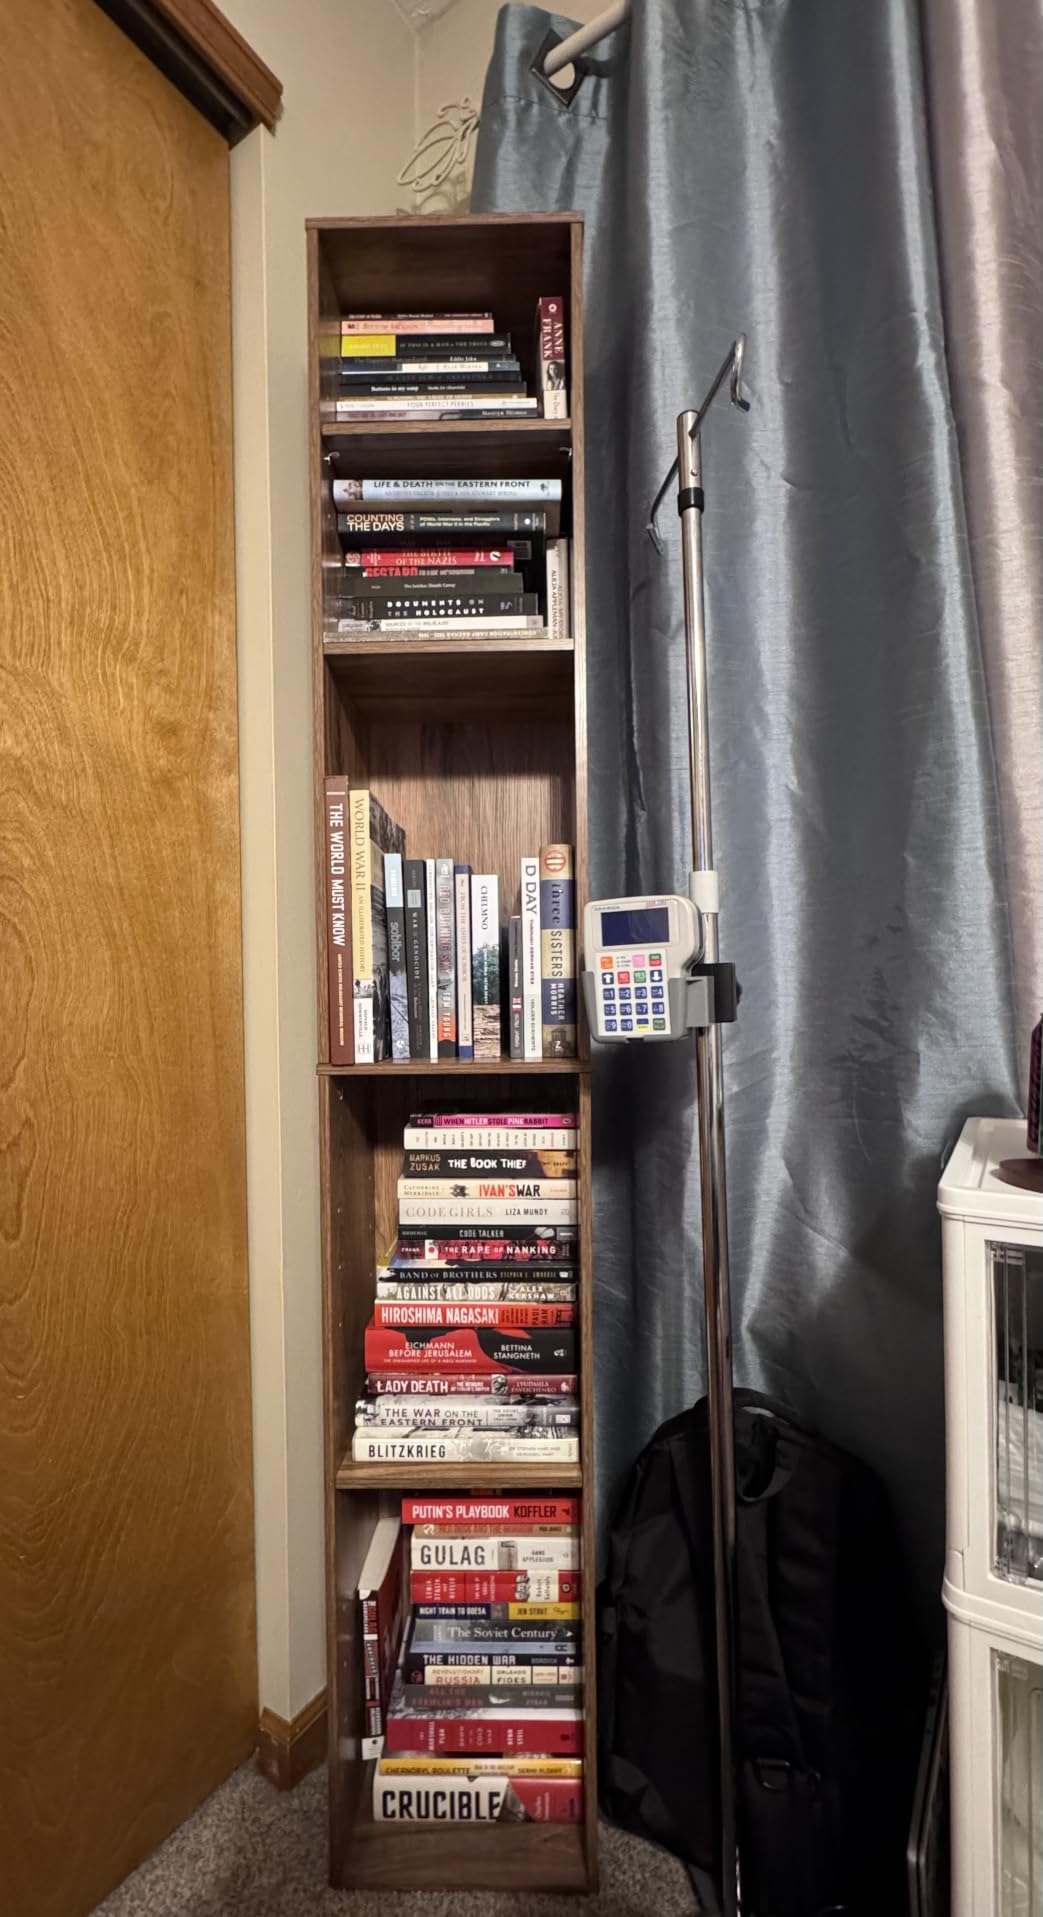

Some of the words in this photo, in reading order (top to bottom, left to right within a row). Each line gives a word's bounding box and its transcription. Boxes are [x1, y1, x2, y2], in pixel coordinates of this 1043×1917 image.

[543, 318, 552, 358] FRANK
[554, 322, 563, 354] ANNE
[347, 522, 371, 531] THE
[373, 522, 404, 531] DAYS
[427, 556, 457, 564] NAZIS
[387, 600, 461, 608] DOCUMENTS
[416, 608, 484, 616] HOLOCAUST
[330, 803, 343, 827] THE
[354, 799, 365, 846] WORLD
[330, 832, 344, 875] WORLD
[356, 851, 366, 878] WAR
[526, 865, 536, 876] D
[332, 880, 344, 911] MUST
[440, 886, 450, 904] RED
[526, 882, 537, 914] DAY
[552, 884, 564, 923] three
[332, 913, 345, 946] KNOW
[440, 909, 451, 950] BURNING
[391, 922, 402, 962] sobibor
[551, 930, 562, 977] SISTERS
[441, 955, 451, 973] SKY
[410, 1163, 440, 1171] ZUSAK
[448, 1159, 467, 1169] THE
[470, 1157, 497, 1169] BOOK
[500, 1158, 527, 1169] THIEF
[480, 1184, 516, 1197] IVAN'S
[516, 1185, 541, 1197] WAR
[459, 1229, 476, 1237] CODE
[479, 1229, 504, 1237] TALKER
[461, 1246, 490, 1254] RAPE
[506, 1246, 556, 1254] NANKING
[396, 1286, 441, 1300] AGAINST
[446, 1286, 462, 1300] ALL
[467, 1286, 495, 1299] ODDS
[381, 1307, 442, 1324] HIROSHIMA
[446, 1307, 499, 1324] NAGASAKI
[376, 1380, 408, 1392] LADY
[411, 1380, 448, 1392] DEATH
[385, 1408, 408, 1417] THE
[413, 1408, 440, 1417] WAR
[368, 1445, 446, 1457] BLITZKRIEG
[412, 1505, 453, 1519] PUTIN'S
[456, 1505, 509, 1519] PLAYBOOK
[514, 1505, 556, 1518] KOFFLER
[421, 1544, 485, 1565] GULAG
[447, 1627, 471, 1638] The
[474, 1627, 508, 1638] Soviet
[511, 1627, 557, 1640] Century
[423, 1655, 444, 1665] THE
[448, 1655, 488, 1665] HIDDEN
[493, 1655, 516, 1665] WAR
[382, 1790, 500, 1819] CRUCIBLE
